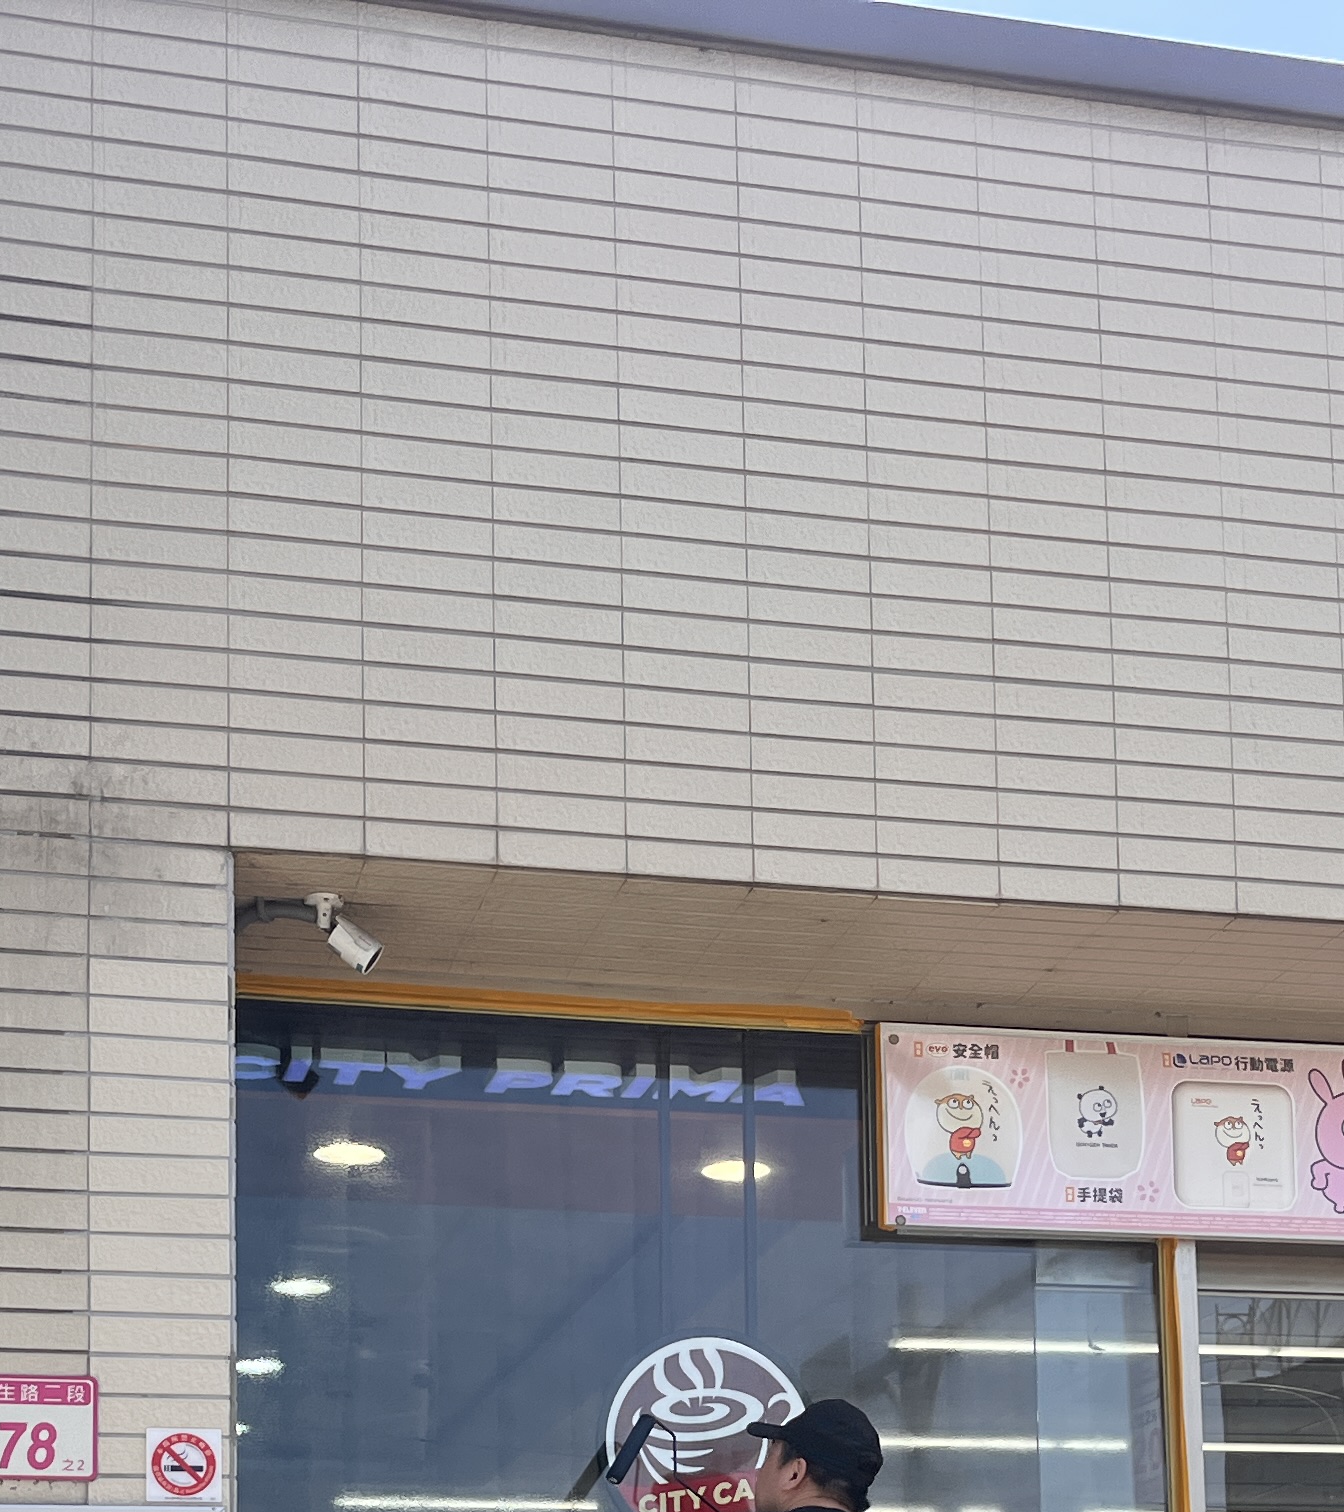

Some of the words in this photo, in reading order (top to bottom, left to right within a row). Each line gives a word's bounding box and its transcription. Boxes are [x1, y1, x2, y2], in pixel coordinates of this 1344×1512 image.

[952, 1043, 1000, 1060] 安全帽
[1234, 1056, 1295, 1074] 行動電源
[484, 1056, 806, 1107] PRIMA
[1076, 1187, 1123, 1205] 手提袋
[61, 1458, 85, 1472] 之2
